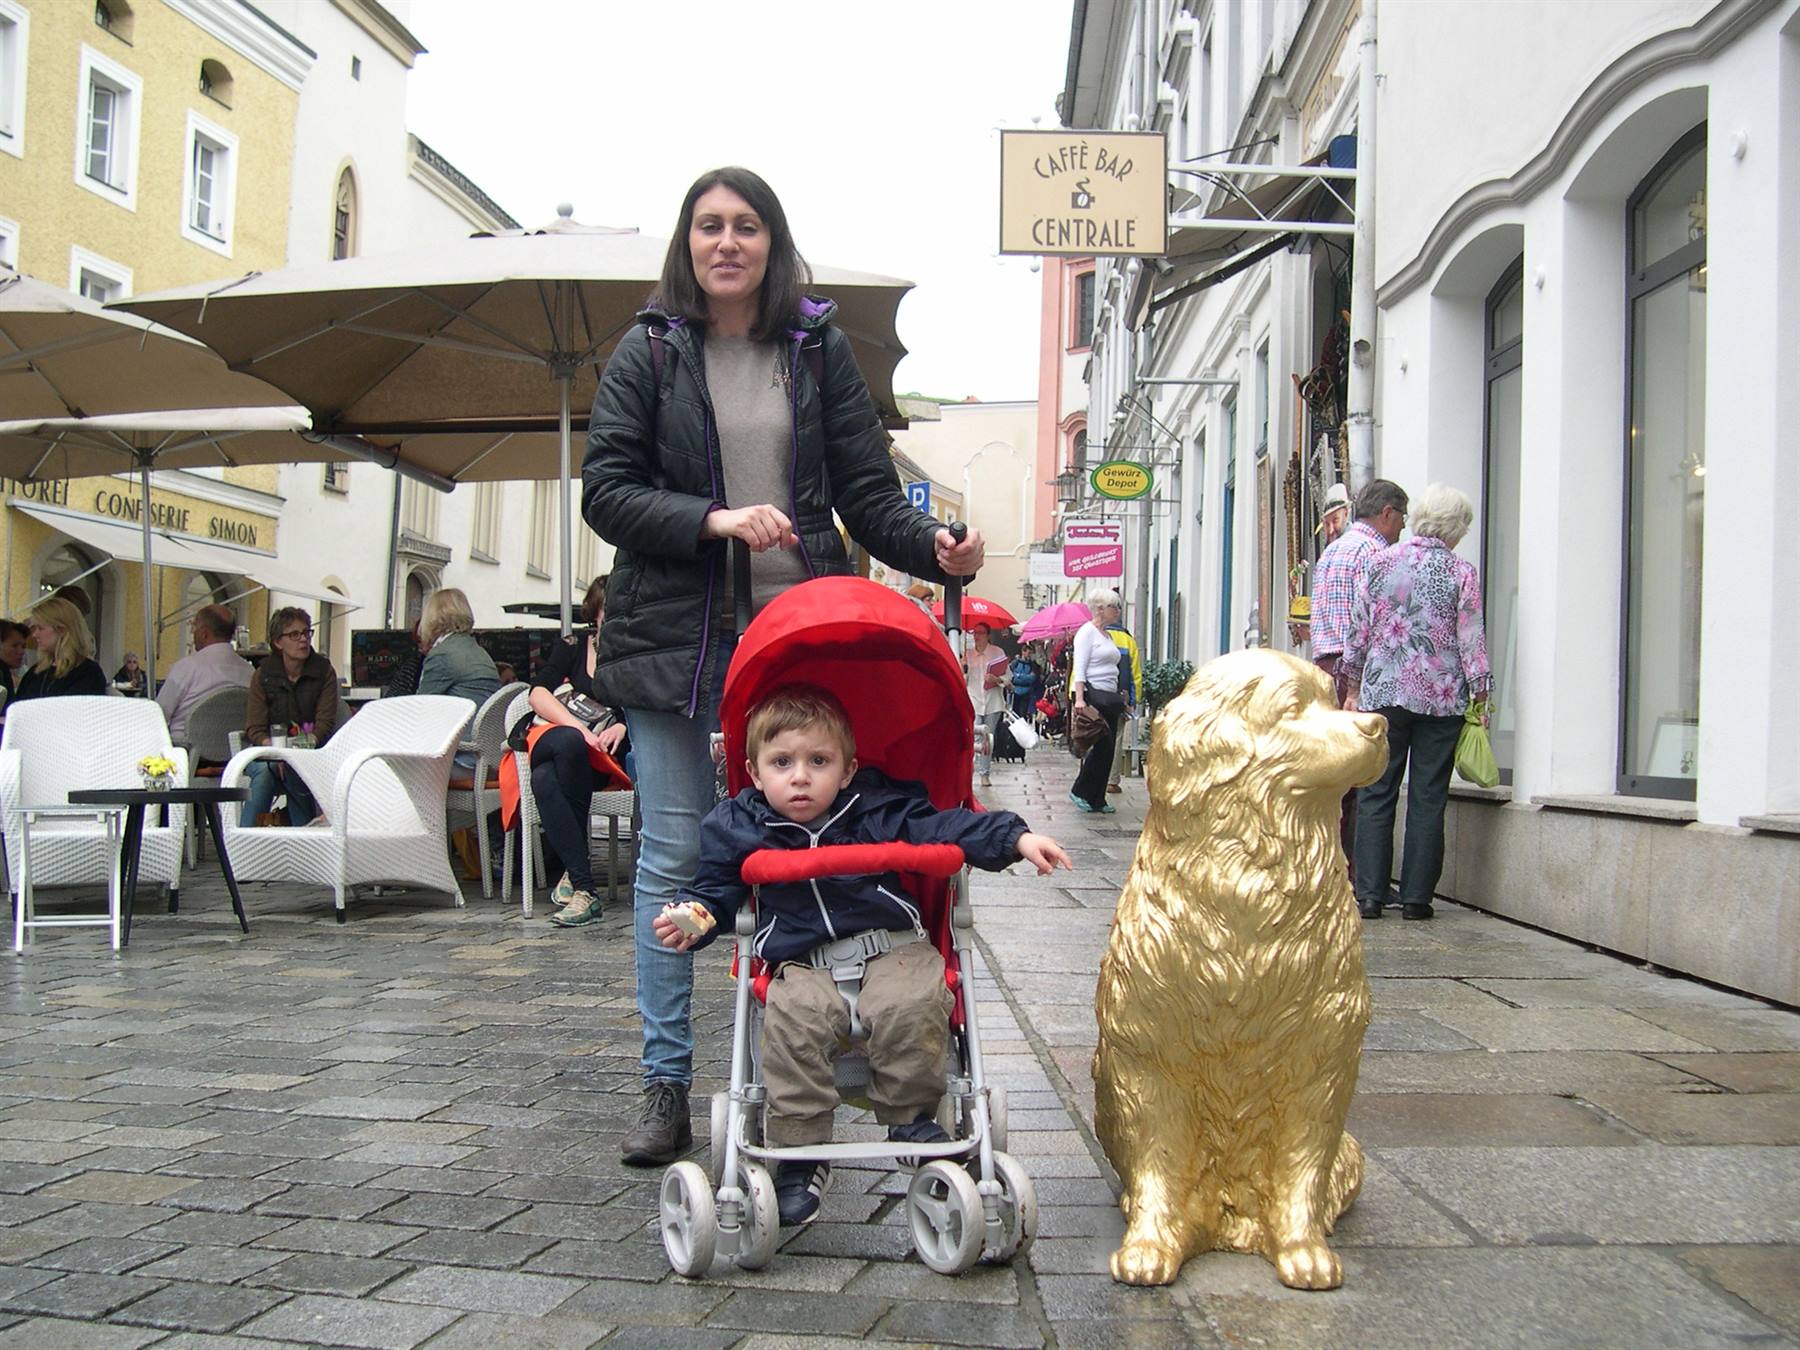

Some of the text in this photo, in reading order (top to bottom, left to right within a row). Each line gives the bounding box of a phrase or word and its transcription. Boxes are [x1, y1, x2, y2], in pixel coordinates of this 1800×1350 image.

[1034, 140, 1133, 182] CAFFÈ BAR
[1032, 217, 1136, 248] CENTRALE
[1102, 468, 1142, 478] Gewürz
[1106, 478, 1138, 489] Depot
[912, 488, 926, 507] P
[95, 490, 190, 532] CONFSERIE
[209, 516, 258, 546] SIMON
